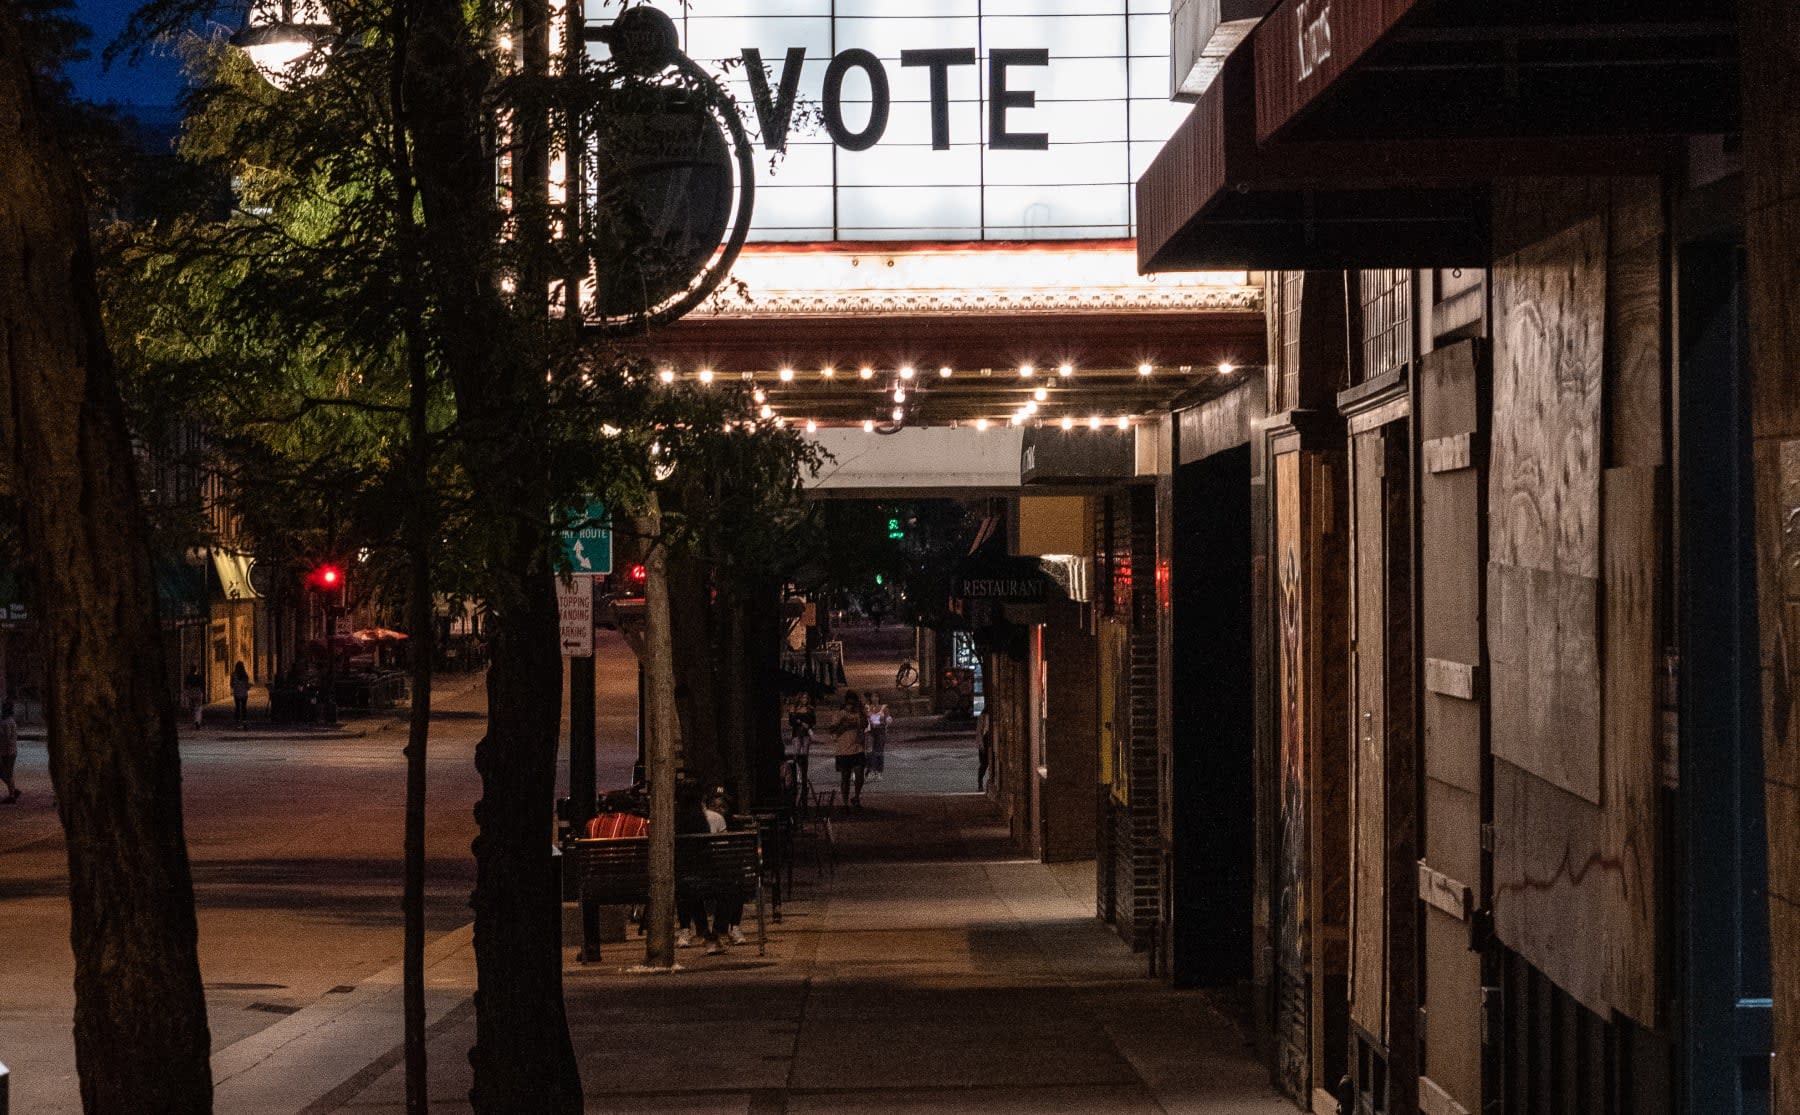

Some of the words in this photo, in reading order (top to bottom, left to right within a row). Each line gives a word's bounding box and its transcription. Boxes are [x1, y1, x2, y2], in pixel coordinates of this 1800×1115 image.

[741, 47, 1048, 151] VOTE
[579, 529, 608, 539] ROUTE
[962, 579, 1044, 596] RESTAURANT
[559, 596, 590, 608] TOPPING
[560, 626, 587, 638] ARKING
